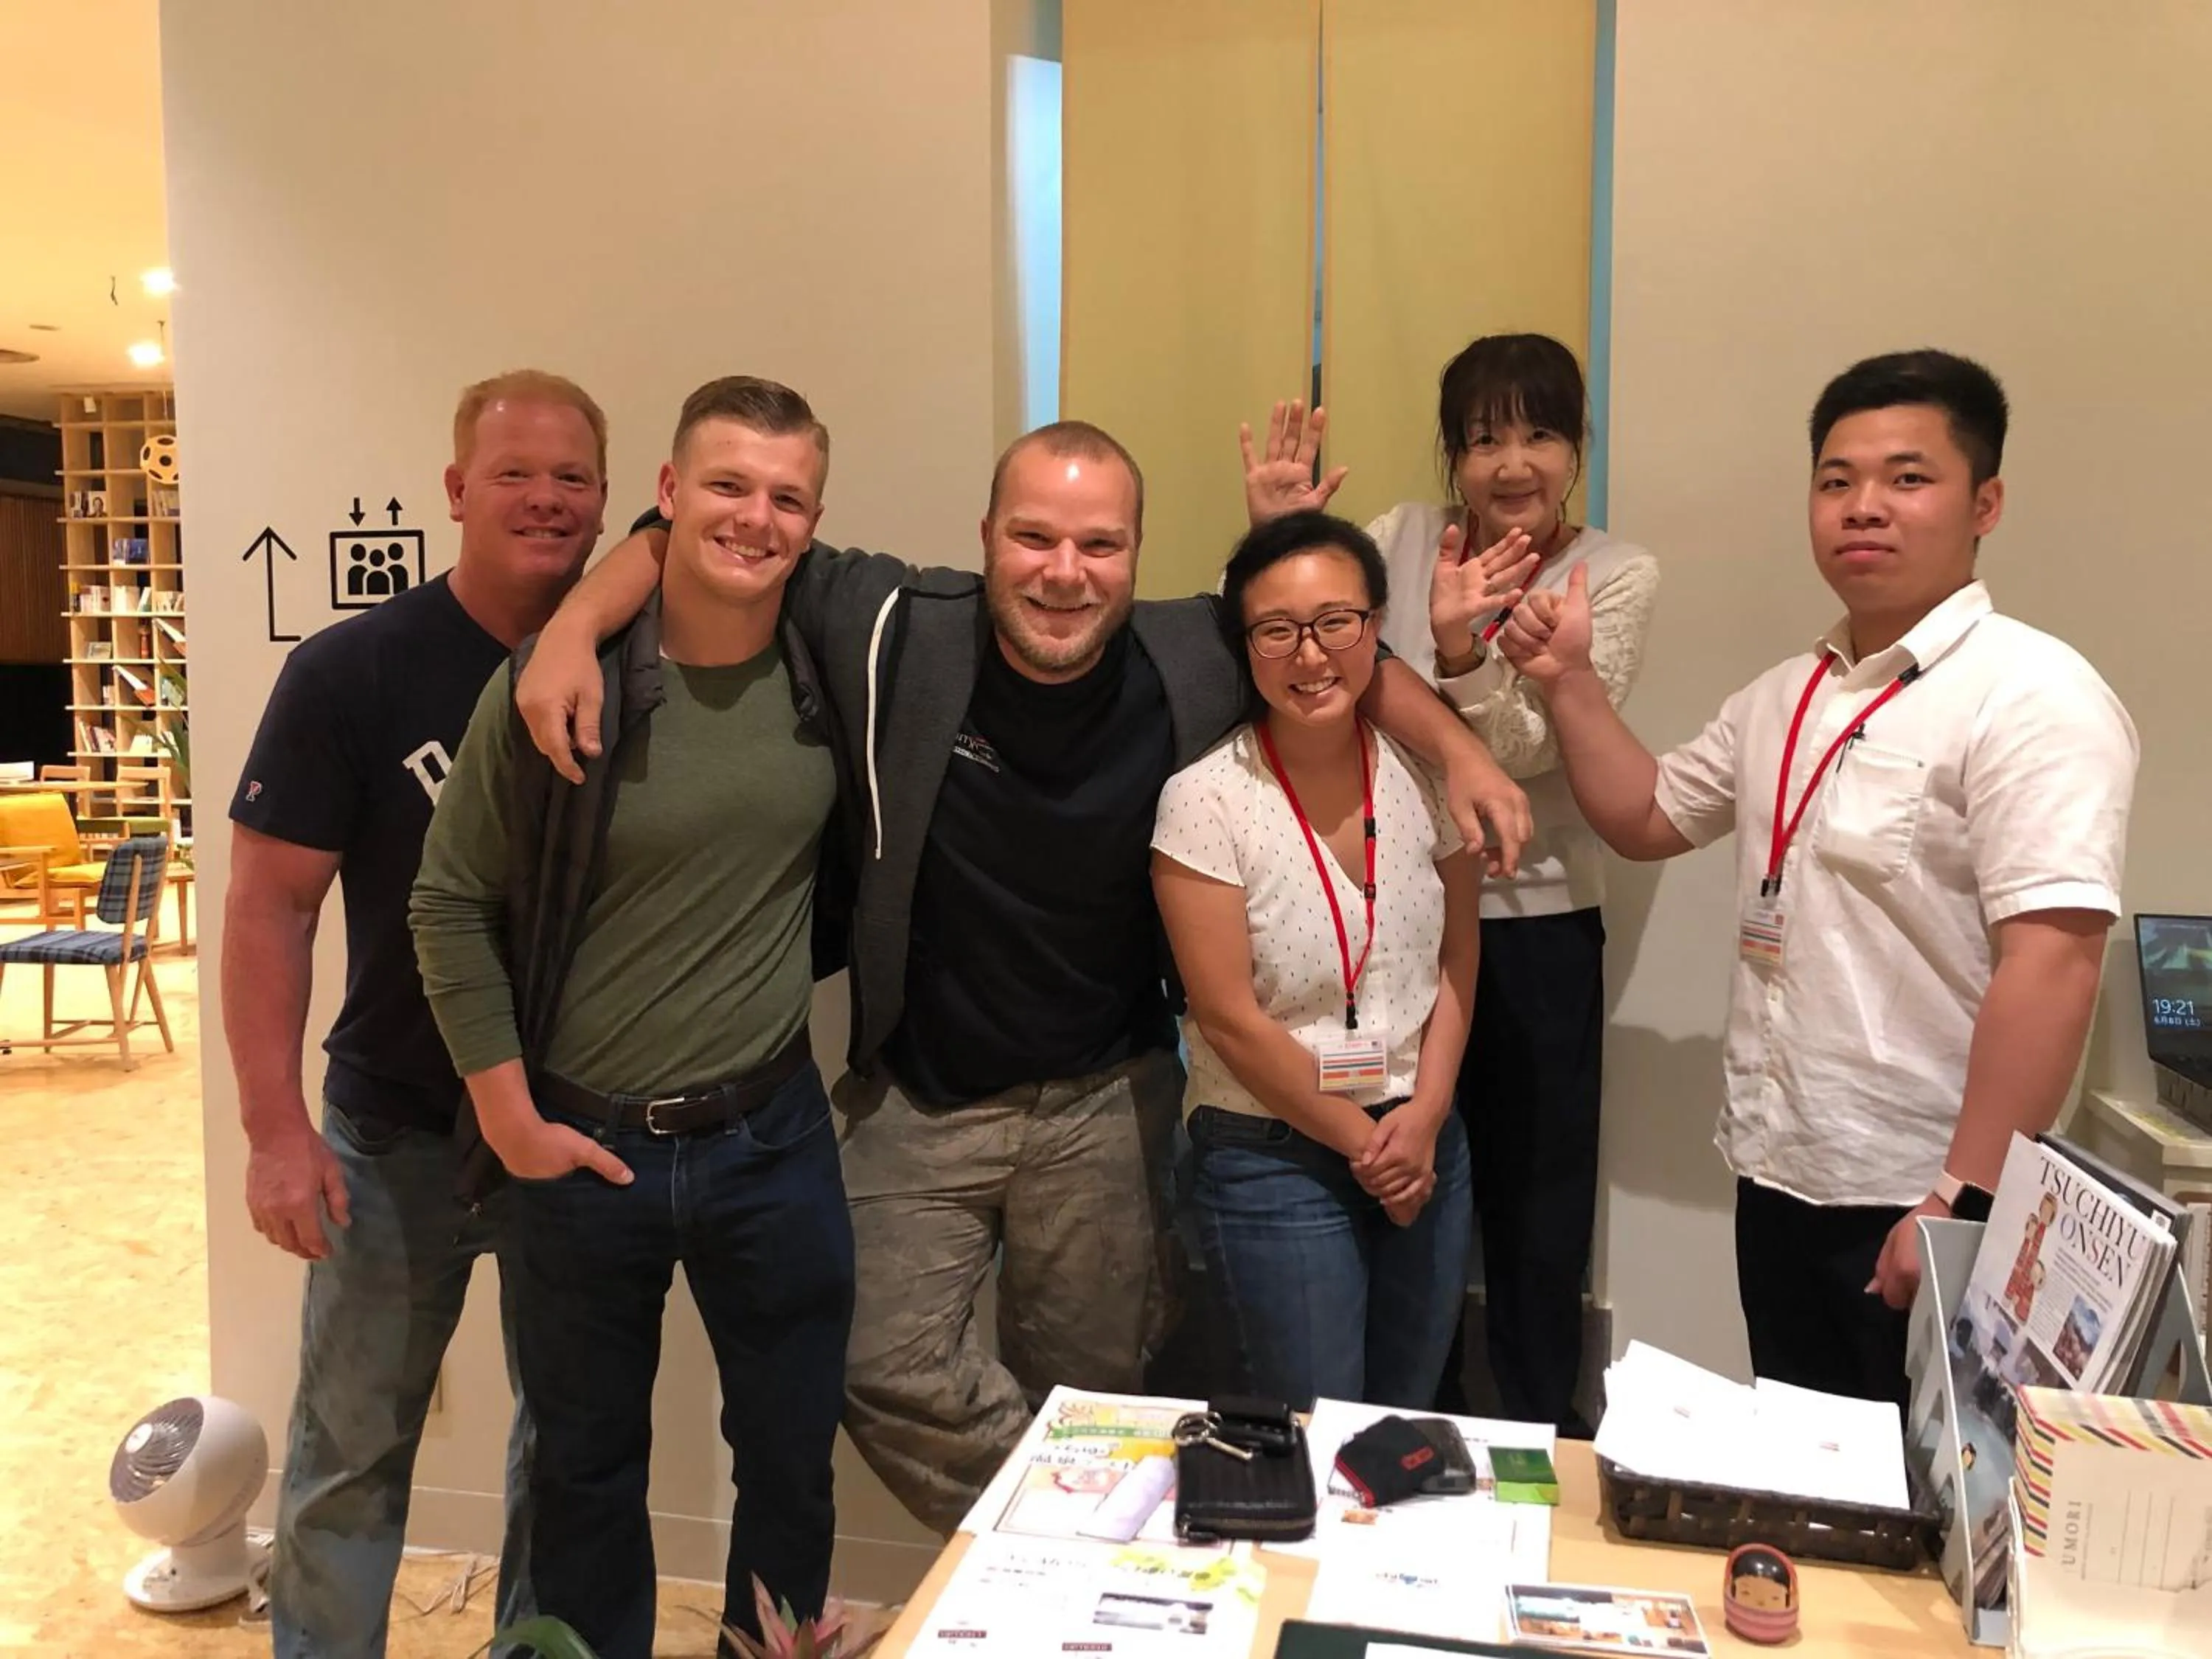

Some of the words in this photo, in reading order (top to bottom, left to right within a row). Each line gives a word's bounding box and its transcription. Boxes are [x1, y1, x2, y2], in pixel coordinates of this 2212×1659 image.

[2152, 999, 2194, 1015] 19:21
[2041, 1156, 2146, 1259] TSUCHIYU
[2060, 1213, 2132, 1289] ONSEN
